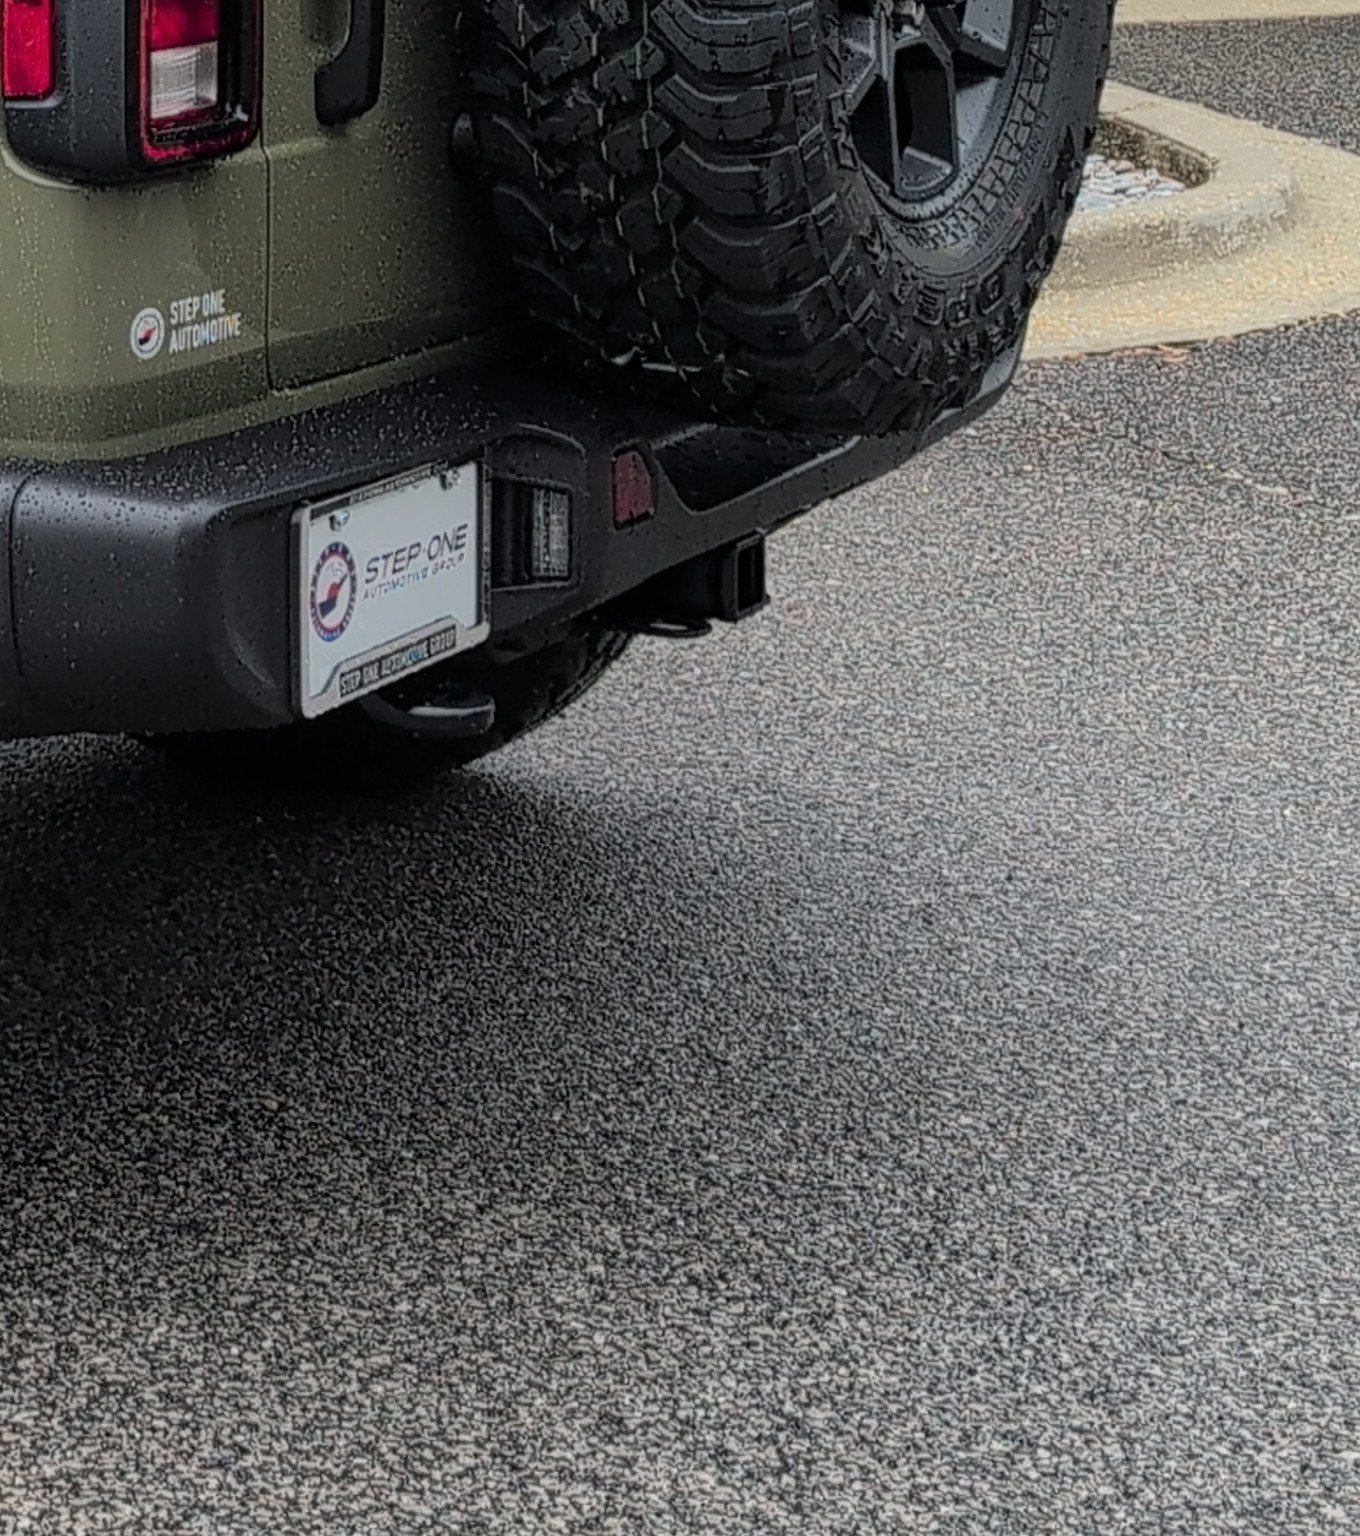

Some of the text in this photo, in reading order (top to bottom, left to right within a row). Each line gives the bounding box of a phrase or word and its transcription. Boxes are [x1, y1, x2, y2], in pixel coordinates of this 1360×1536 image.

[169, 288, 226, 325] STEP ONE
[168, 312, 241, 354] AUTOMOTIVE
[364, 523, 468, 584] STEP ONE
